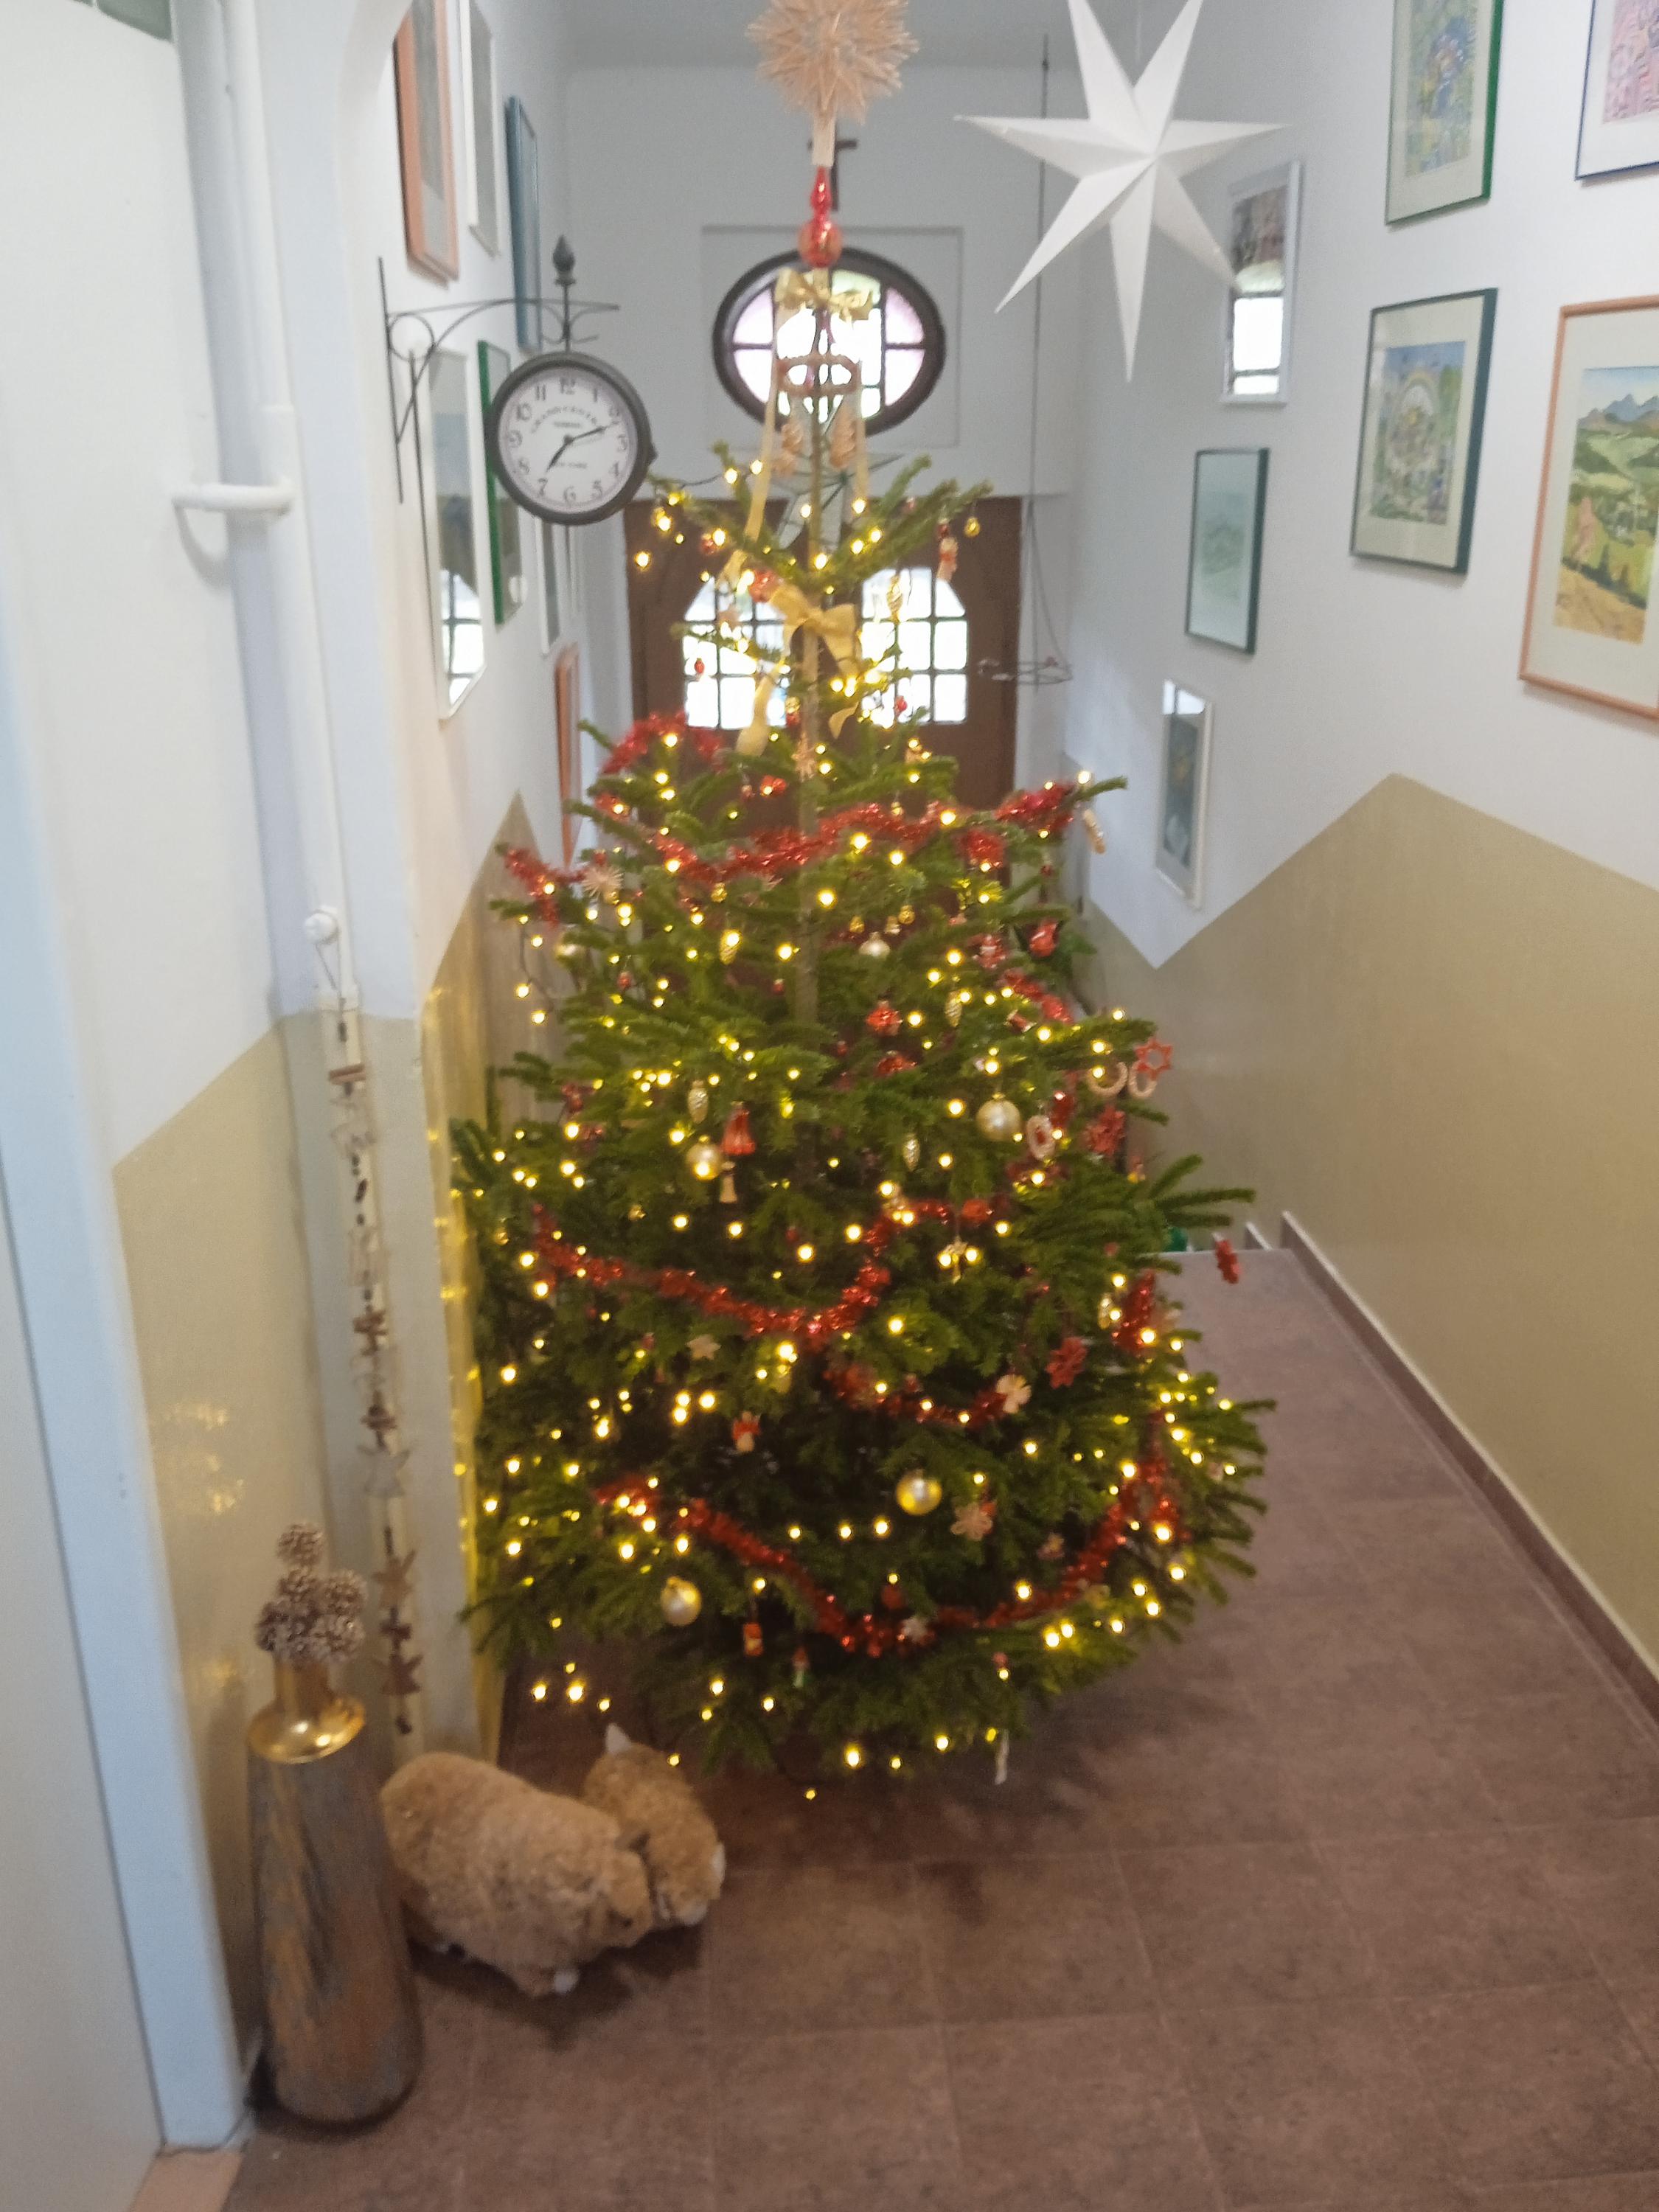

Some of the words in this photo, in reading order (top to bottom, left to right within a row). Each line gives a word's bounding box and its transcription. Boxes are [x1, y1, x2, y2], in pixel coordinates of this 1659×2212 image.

[535, 384, 546, 401] 11
[560, 377, 576, 395] 12
[516, 403, 532, 421] 10
[609, 408, 620, 425] 2
[507, 430, 523, 448] 9
[616, 434, 627, 451] 3
[518, 459, 530, 473] 8
[608, 462, 619, 477] 4
[538, 477, 548, 496] 7
[563, 485, 576, 503] 6
[591, 479, 602, 498] 5
